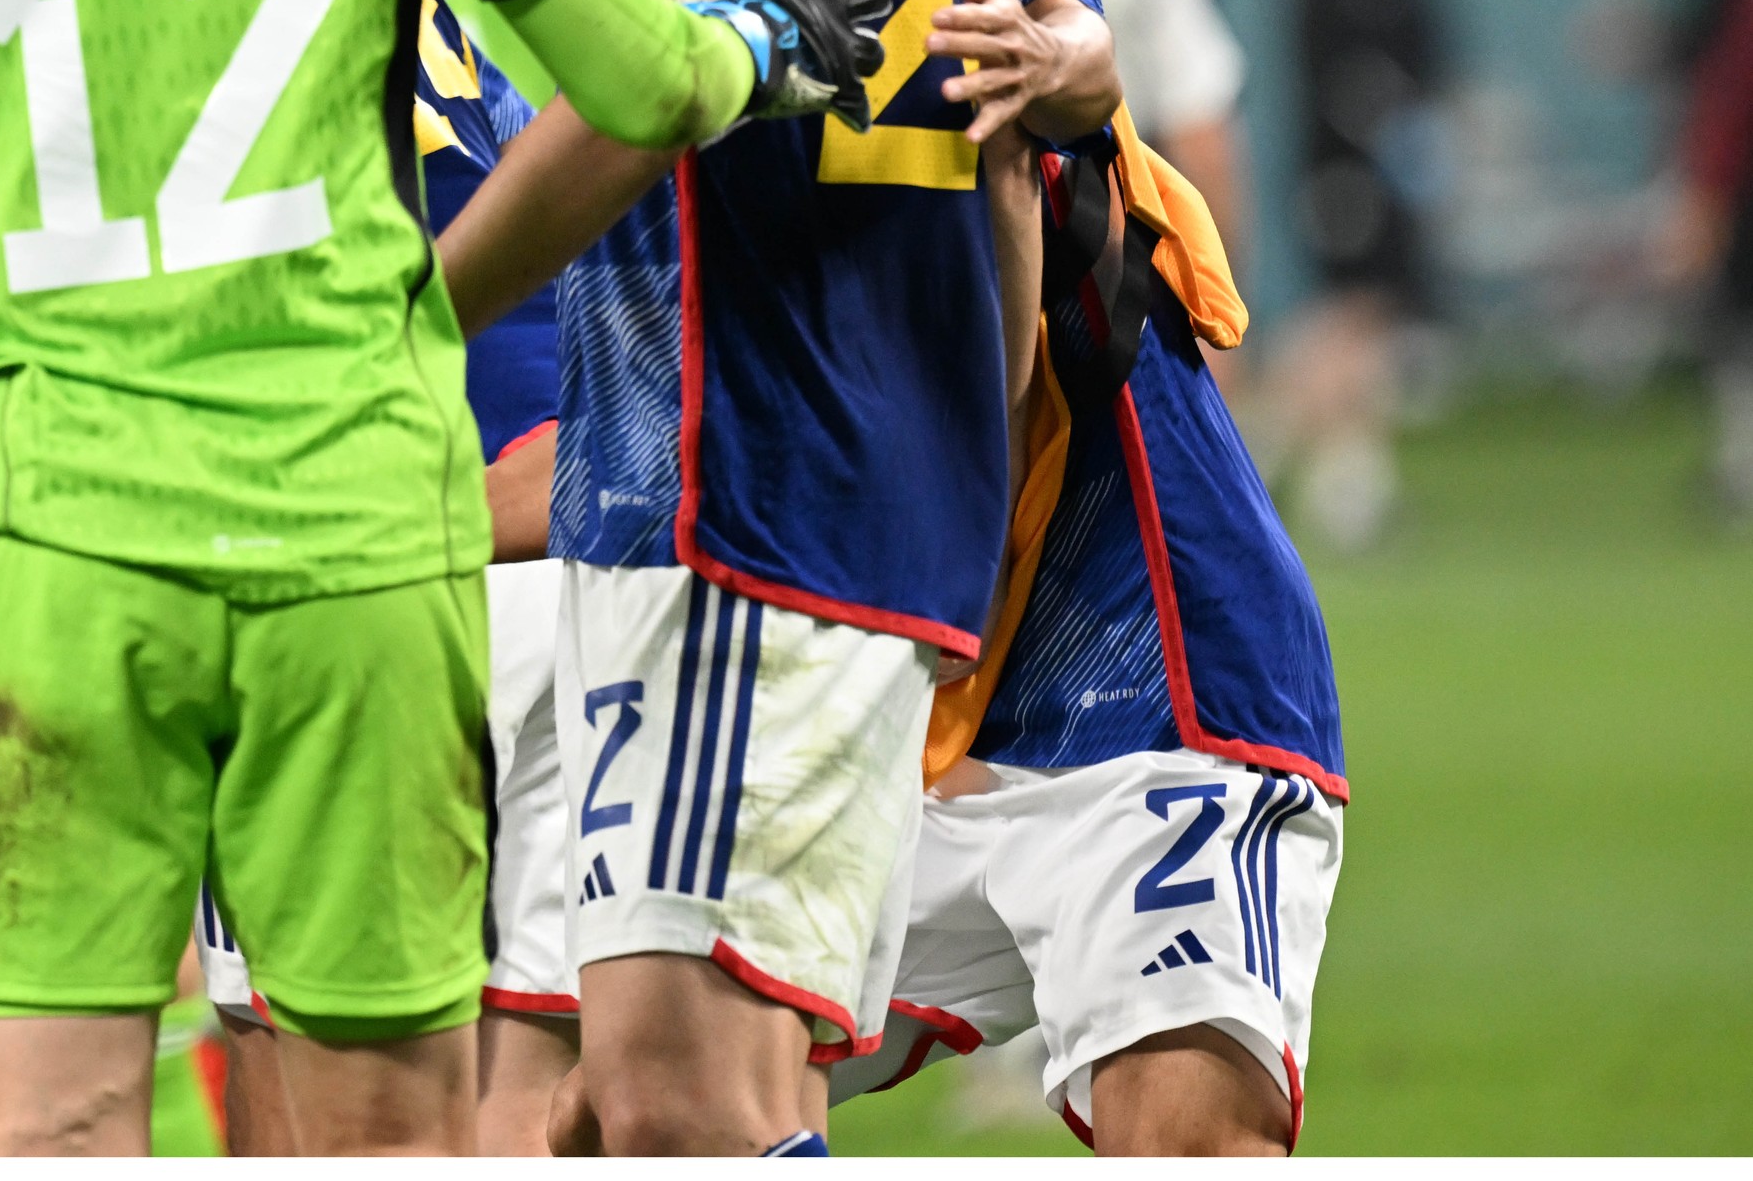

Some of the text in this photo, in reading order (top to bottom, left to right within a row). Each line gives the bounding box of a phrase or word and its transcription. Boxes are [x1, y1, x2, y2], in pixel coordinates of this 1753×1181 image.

[581, 680, 644, 839] 2
[1098, 687, 1141, 703] HEAT.RDY
[1135, 783, 1227, 913] 2
